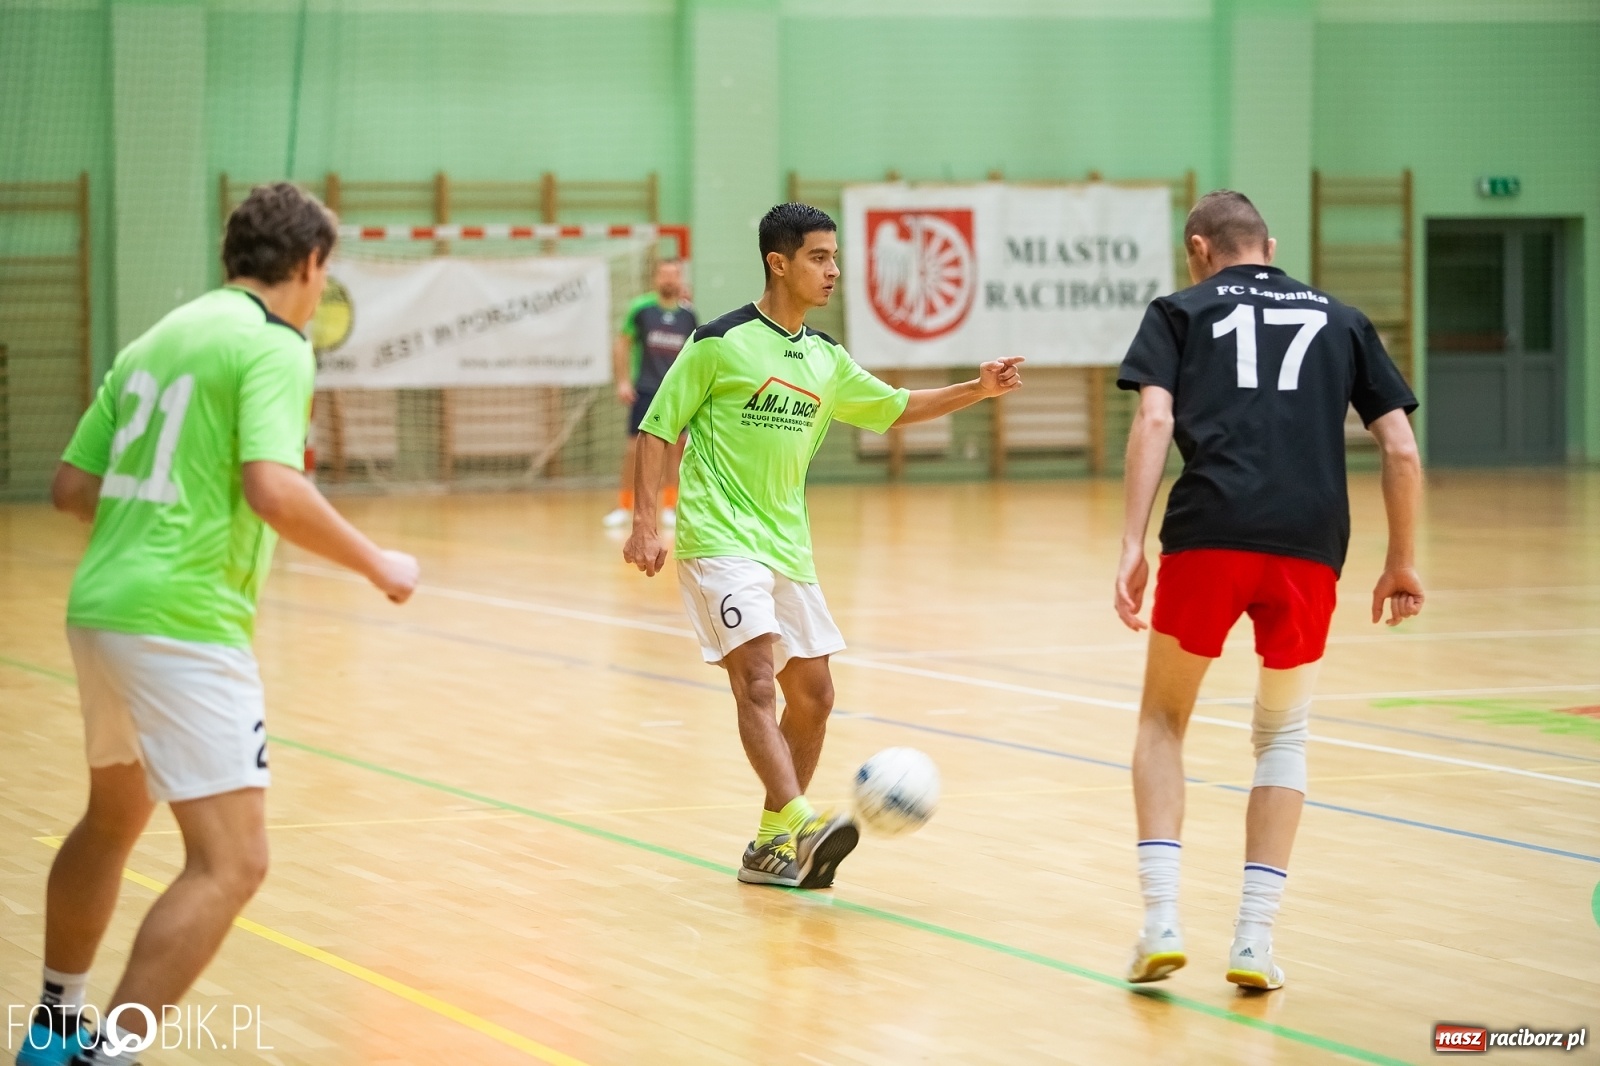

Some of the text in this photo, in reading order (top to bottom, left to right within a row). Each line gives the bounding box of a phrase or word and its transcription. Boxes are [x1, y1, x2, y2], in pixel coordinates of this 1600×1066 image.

[1005, 235, 1140, 269] MIASTO
[1216, 285, 1246, 296] FC
[370, 330, 425, 369] JEST
[784, 350, 804, 359] JAKO
[1212, 303, 1329, 391] 17
[741, 413, 770, 421] USŁUGI
[743, 393, 789, 414] A.M.J.
[100, 370, 195, 503] 21
[741, 421, 803, 432] SYRYNIA
[720, 593, 742, 629] 6
